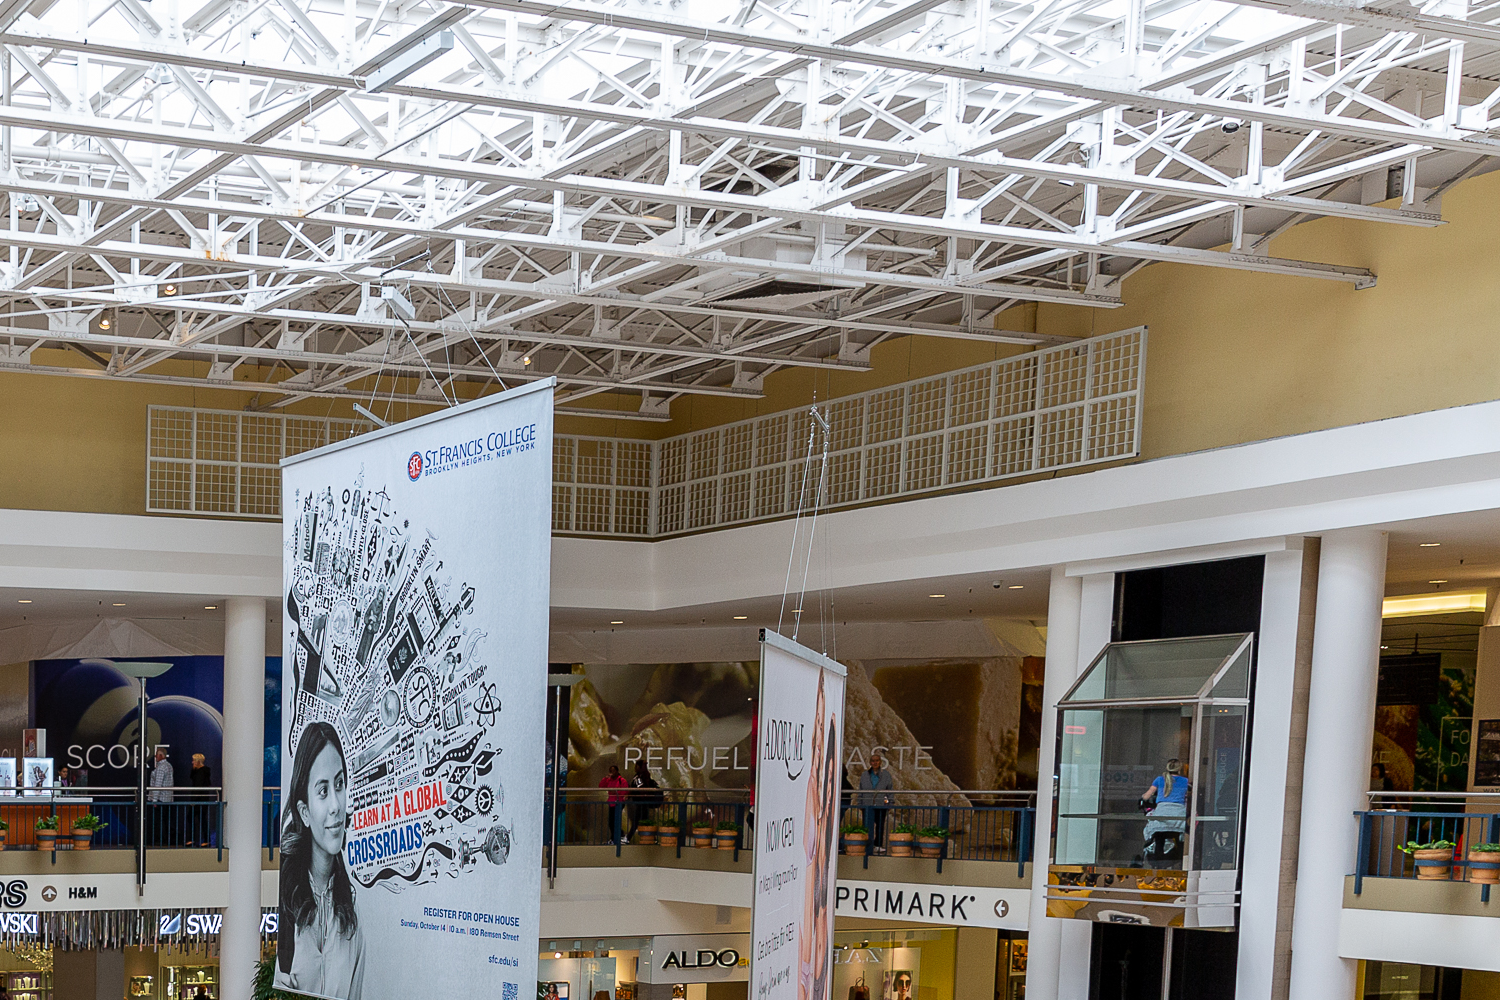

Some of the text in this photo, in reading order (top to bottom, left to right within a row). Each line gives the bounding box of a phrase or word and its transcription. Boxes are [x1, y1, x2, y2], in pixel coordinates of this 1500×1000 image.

[486, 424, 536, 452] COLLEGE
[425, 442, 535, 477] BROOKLYN HEIGHTS, NEW YORK
[400, 538, 434, 603] BROOKLYN SMART
[441, 666, 485, 707] BROOKLYN TOUGH
[793, 722, 805, 761] ME
[624, 746, 749, 771] REFUEL
[843, 746, 934, 771] ASTE
[353, 781, 447, 831] LEARN AT A GLOBAL
[348, 822, 423, 867] CROSSROADS
[766, 817, 795, 853] NOW OPEN
[69, 887, 98, 899] H&M
[836, 886, 968, 921] PRIMARK
[400, 919, 419, 930] Sunday,
[420, 922, 440, 931] October
[440, 924, 446, 932] 14
[448, 925, 455, 933] 10
[469, 927, 479, 937] 180
[480, 929, 502, 940] Remsen
[502, 932, 520, 942] Street
[424, 906, 520, 927] REGISTER FOR OPEN HOUSE
[488, 955, 519, 968] sfc.edu/si
[661, 948, 740, 969] ALDO
